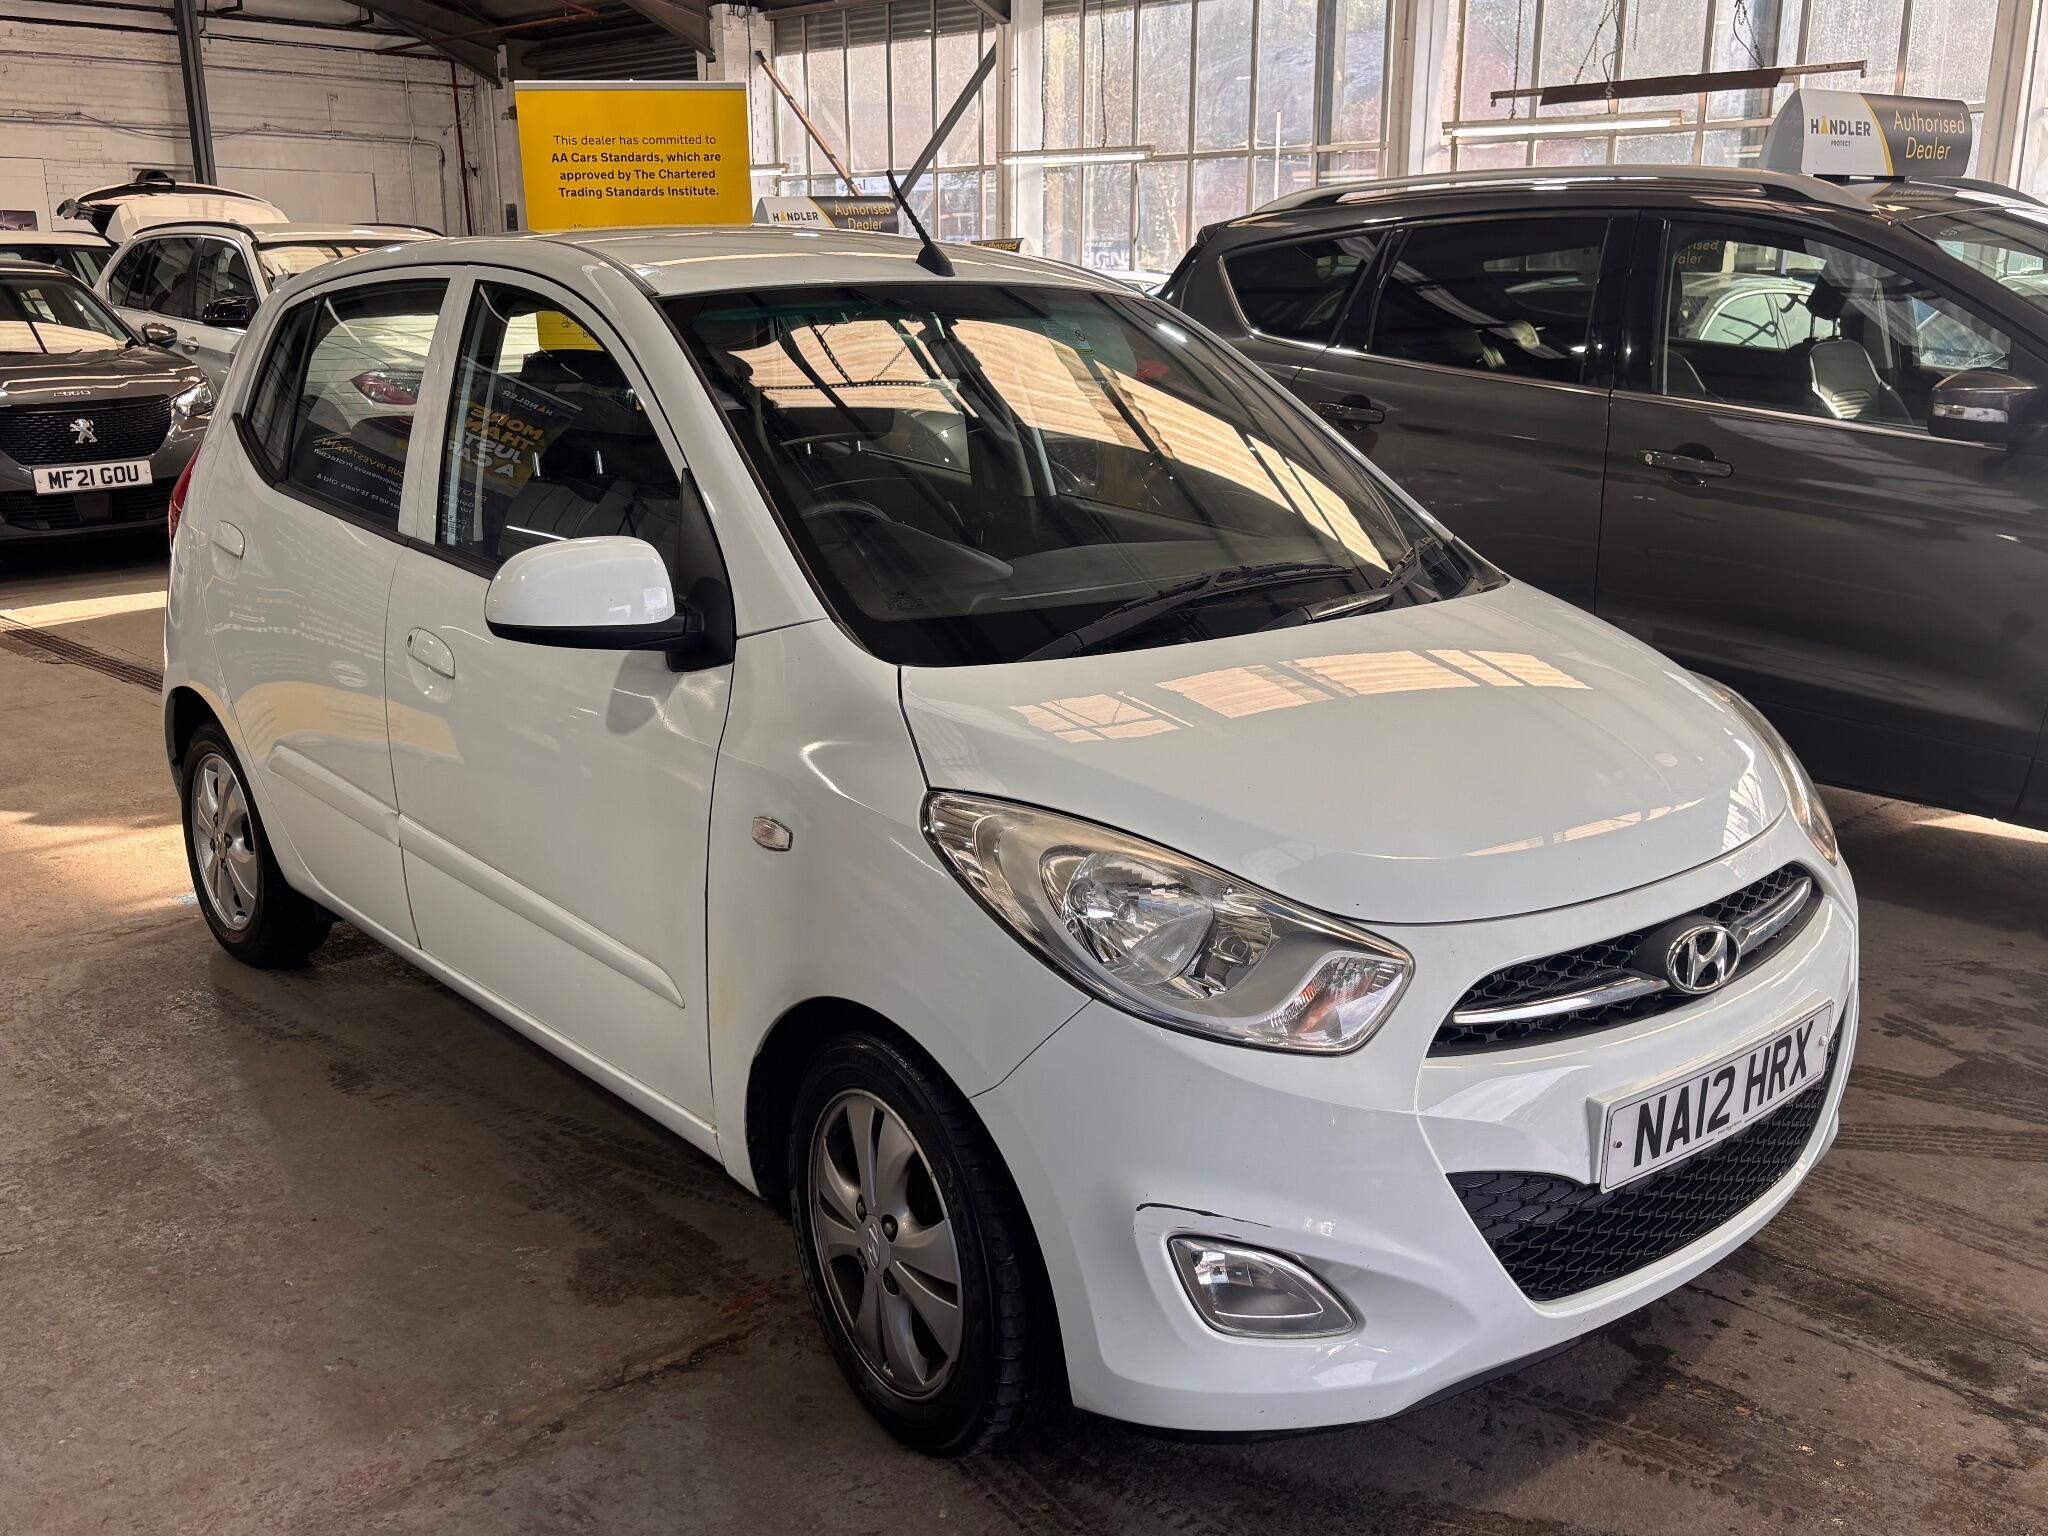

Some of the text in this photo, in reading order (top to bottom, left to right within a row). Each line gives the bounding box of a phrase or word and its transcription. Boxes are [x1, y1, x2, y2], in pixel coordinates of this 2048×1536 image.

[1810, 116, 1871, 137] HANDLER
[1893, 109, 1965, 135] Authorised
[553, 134, 717, 146] This dealer has committed to
[1906, 136, 1952, 161] Dealer
[551, 151, 721, 163] AA Cars Standards, which are
[560, 169, 716, 182] approved by The Chartered
[559, 186, 719, 198] Trading Standards Institute.
[835, 200, 892, 215] Authorised
[772, 211, 819, 222] HANDLER
[847, 217, 883, 231] Dealer
[47, 464, 140, 489] MF21 GOU
[1633, 1020, 1815, 1167] NA12 HRX
